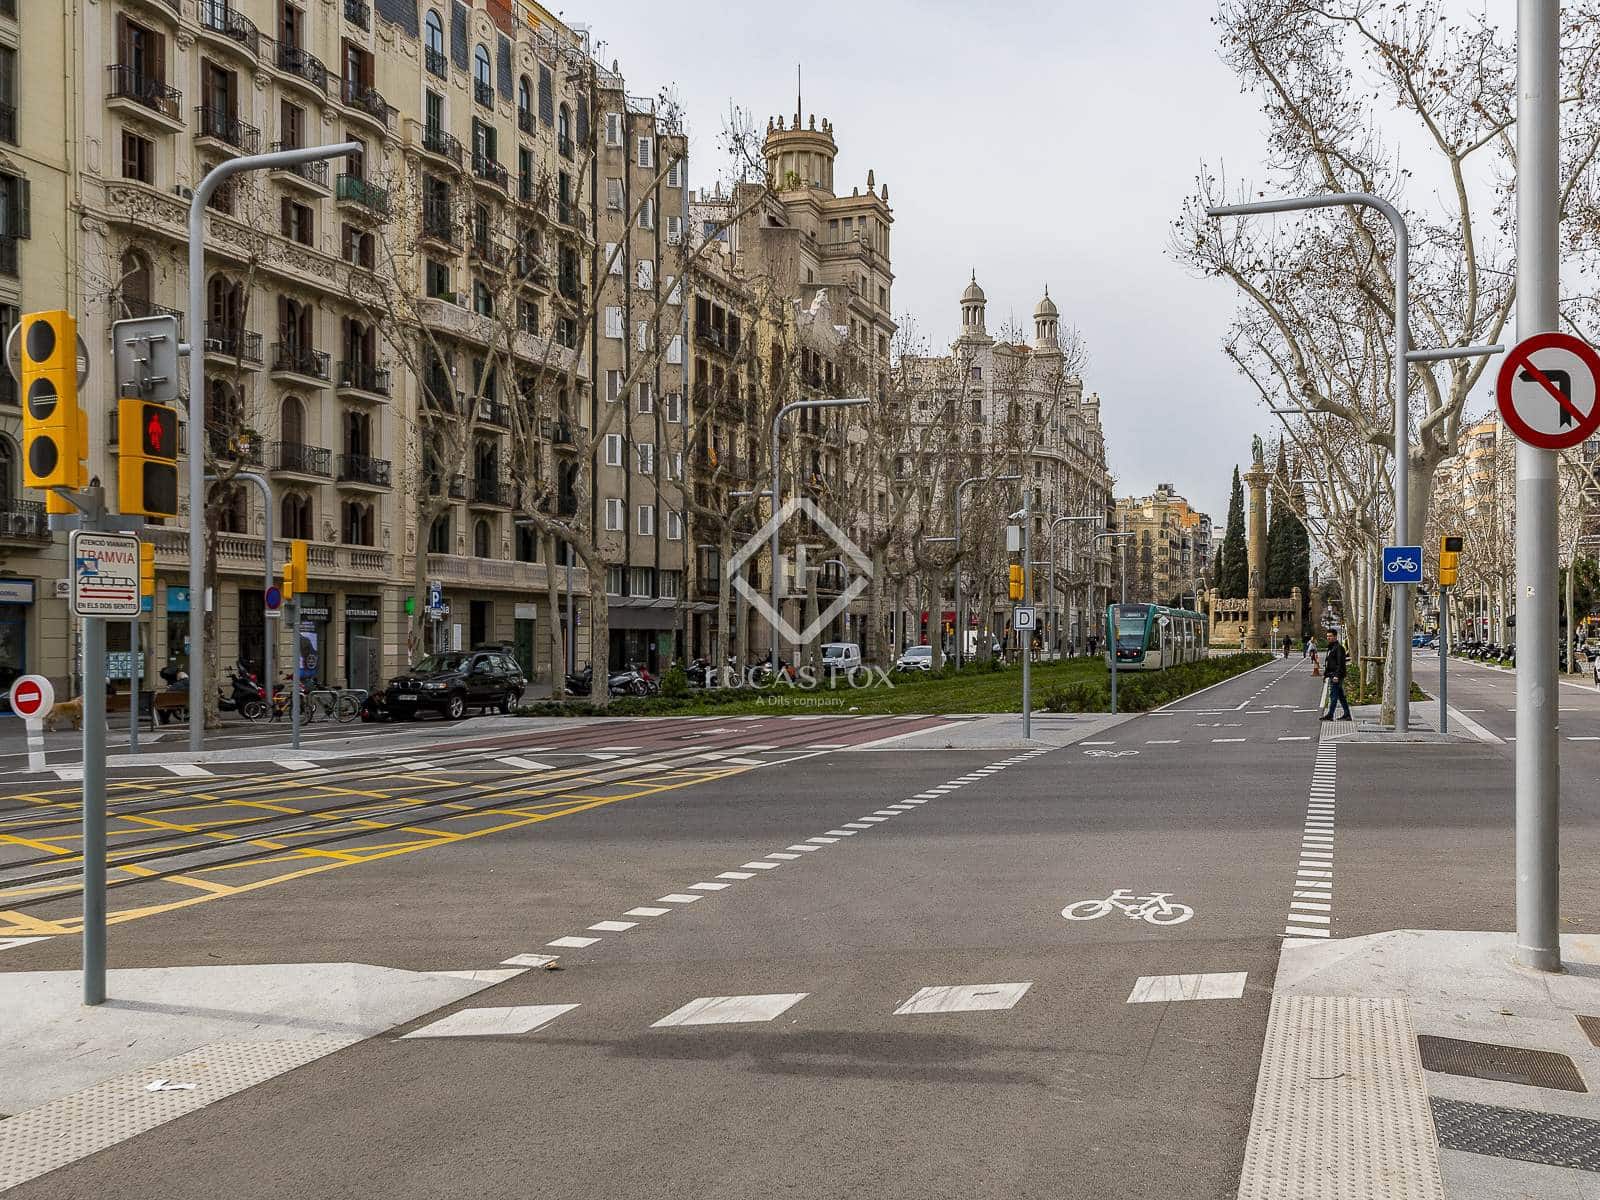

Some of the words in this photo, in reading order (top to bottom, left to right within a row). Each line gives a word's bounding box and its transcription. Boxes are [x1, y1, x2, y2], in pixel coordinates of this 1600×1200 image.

[80, 549, 135, 564] TRAMVIA
[432, 591, 440, 607] P
[1020, 612, 1030, 625] D
